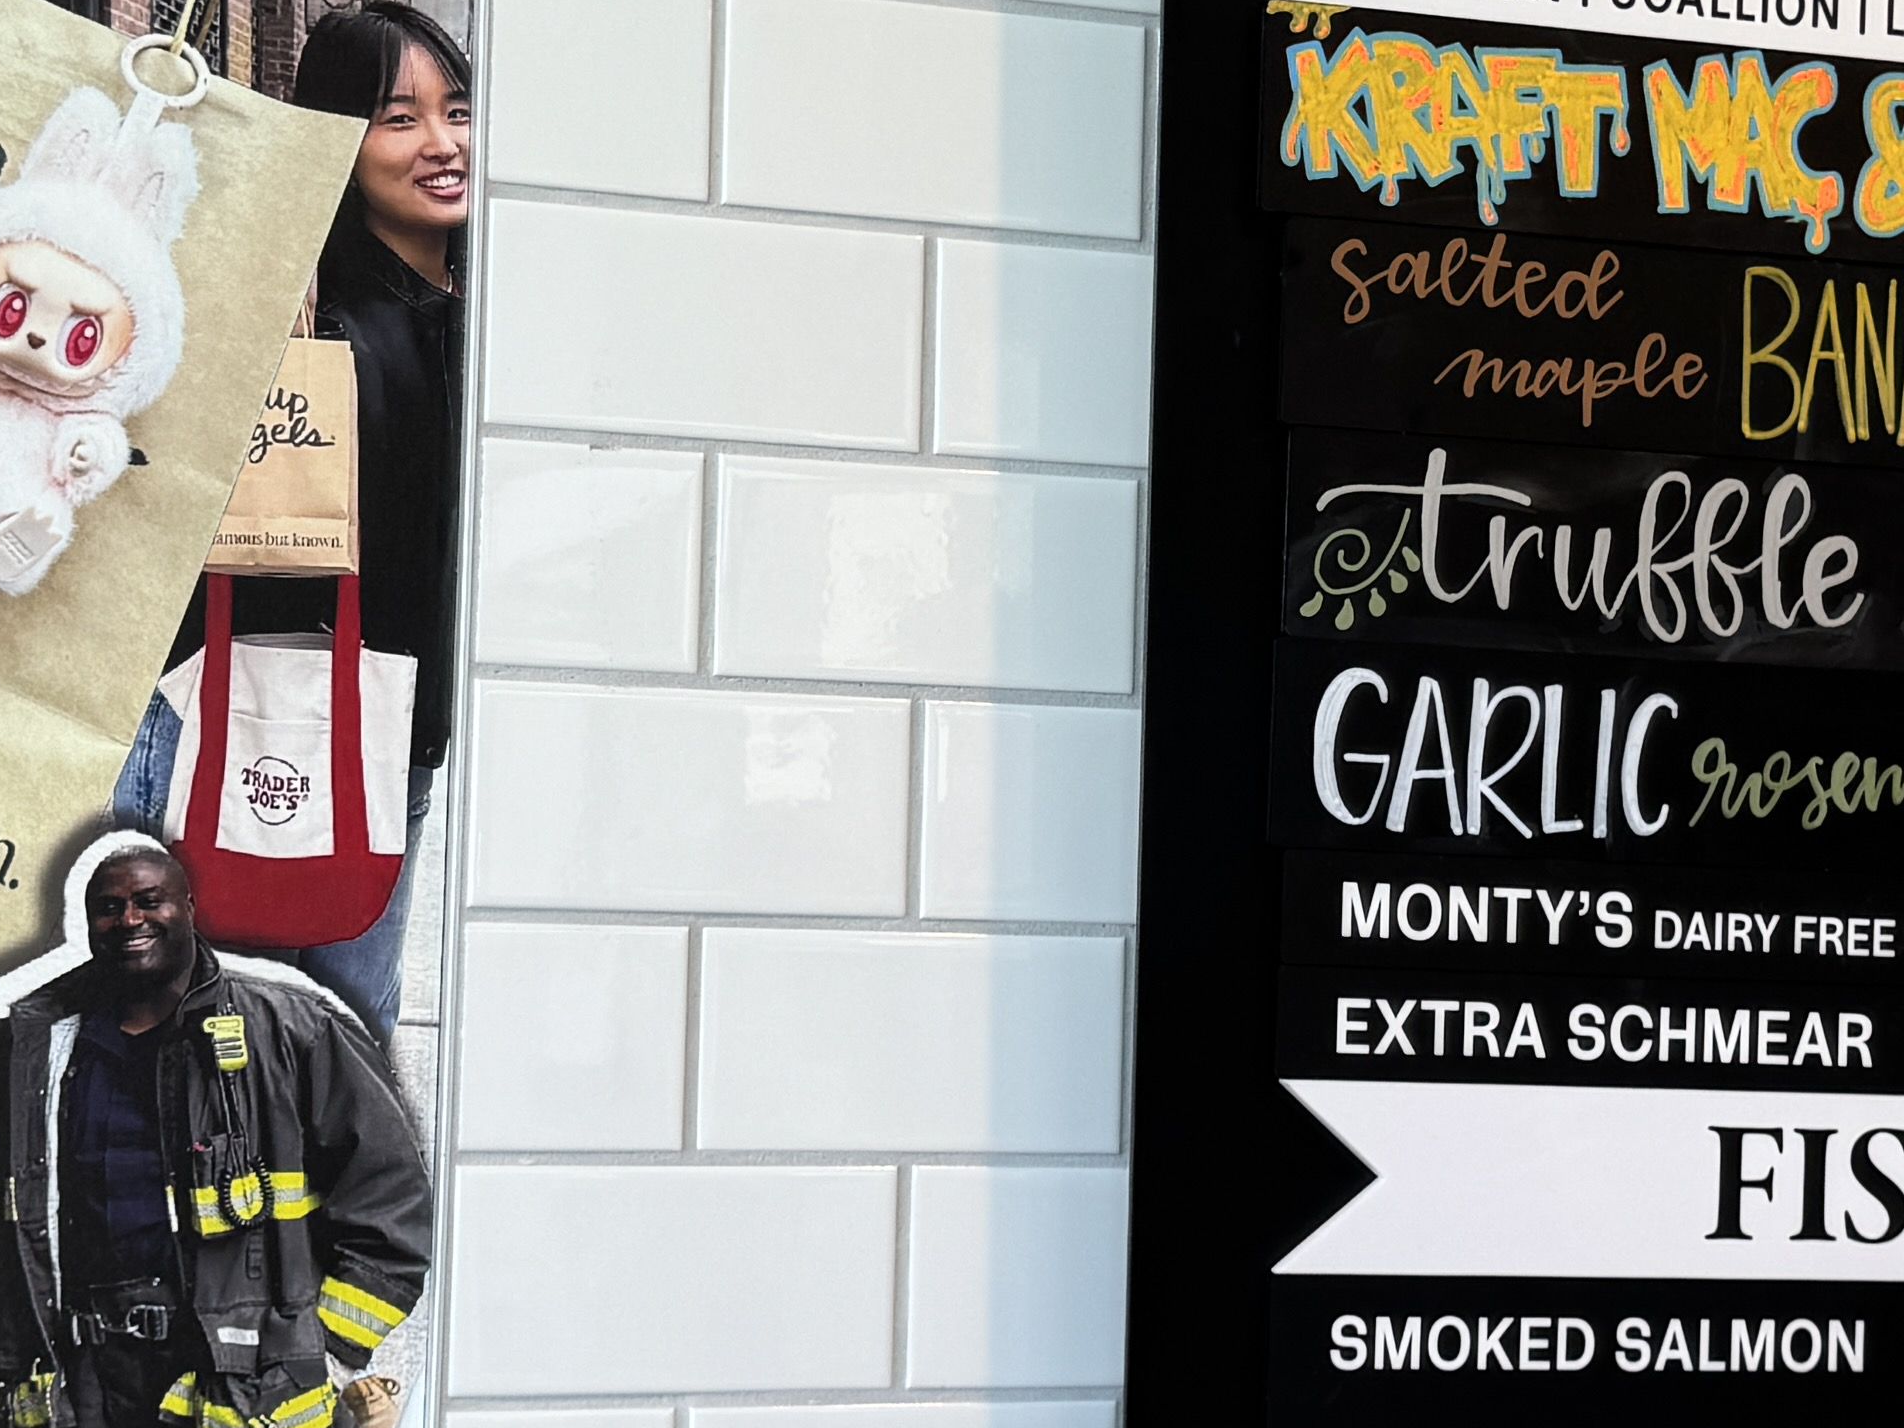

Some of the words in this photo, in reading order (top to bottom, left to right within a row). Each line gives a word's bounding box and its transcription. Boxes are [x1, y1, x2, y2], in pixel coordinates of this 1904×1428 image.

[1281, 32, 1630, 226] KRAFT
[1642, 49, 1843, 254] MAC
[1432, 332, 1709, 429] maple
[265, 531, 289, 547] but
[1315, 446, 1867, 645] truffle
[241, 768, 310, 792] TRADER
[1310, 666, 1681, 842] GARLIC
[1654, 909, 1781, 953] DAIRY
[1793, 915, 1896, 958] FREE
[1335, 997, 1546, 1059] EXTRA
[1567, 1003, 1873, 1068] SCHMEAR
[1329, 1314, 1595, 1371] SMOKED
[1615, 1317, 1865, 1373] SALMON
